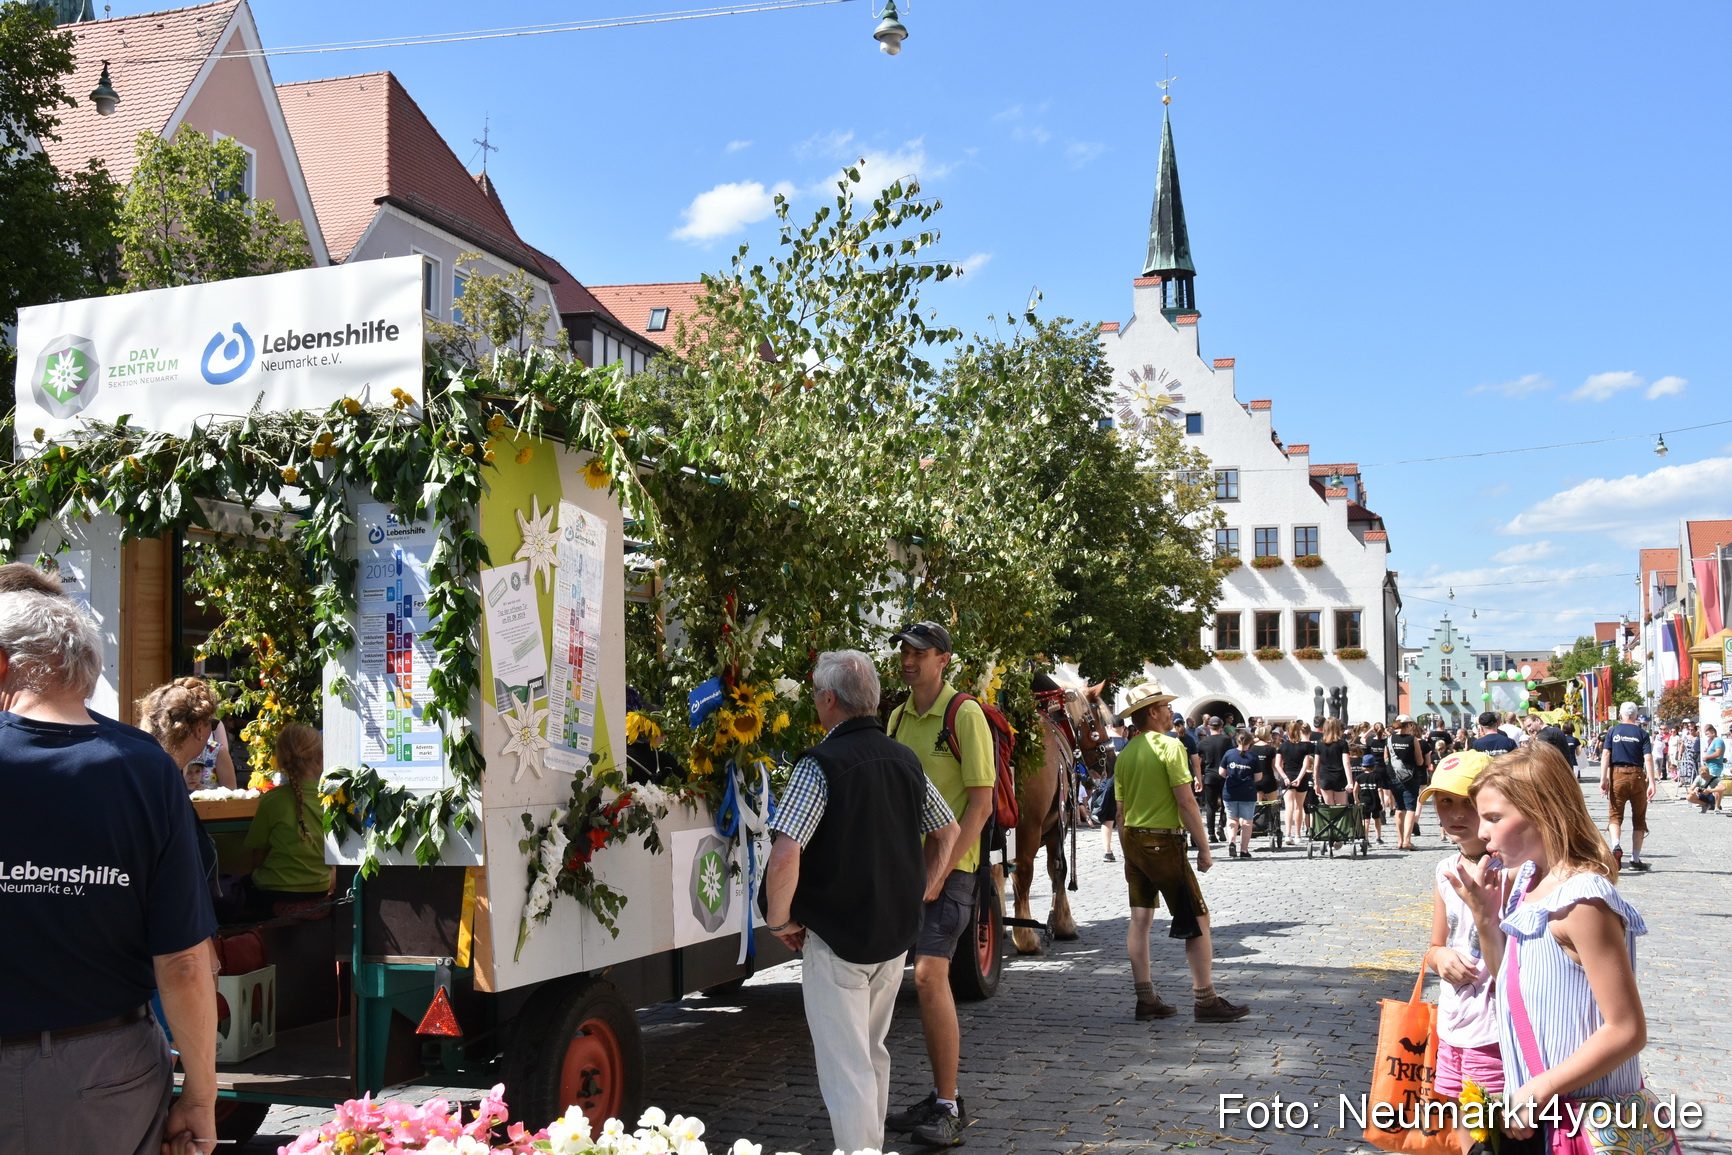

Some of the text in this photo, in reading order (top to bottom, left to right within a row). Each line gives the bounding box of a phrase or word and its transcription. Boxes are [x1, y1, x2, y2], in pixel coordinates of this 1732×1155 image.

[262, 319, 400, 354] Lebenshilfe
[129, 348, 160, 363] DAV
[260, 352, 343, 373] Neumarkt e.V.
[108, 358, 179, 378] ZENTRUM
[107, 373, 179, 389] SEKTION NEUMARKT
[386, 526, 426, 537] Lebenshilfe
[366, 563, 396, 579] 2019
[0, 861, 130, 886] Lebenshilfe
[0, 882, 85, 896] Neumarkt e.V.
[1387, 1056, 1436, 1084] TRICK
[1420, 1086, 1431, 1096] or
